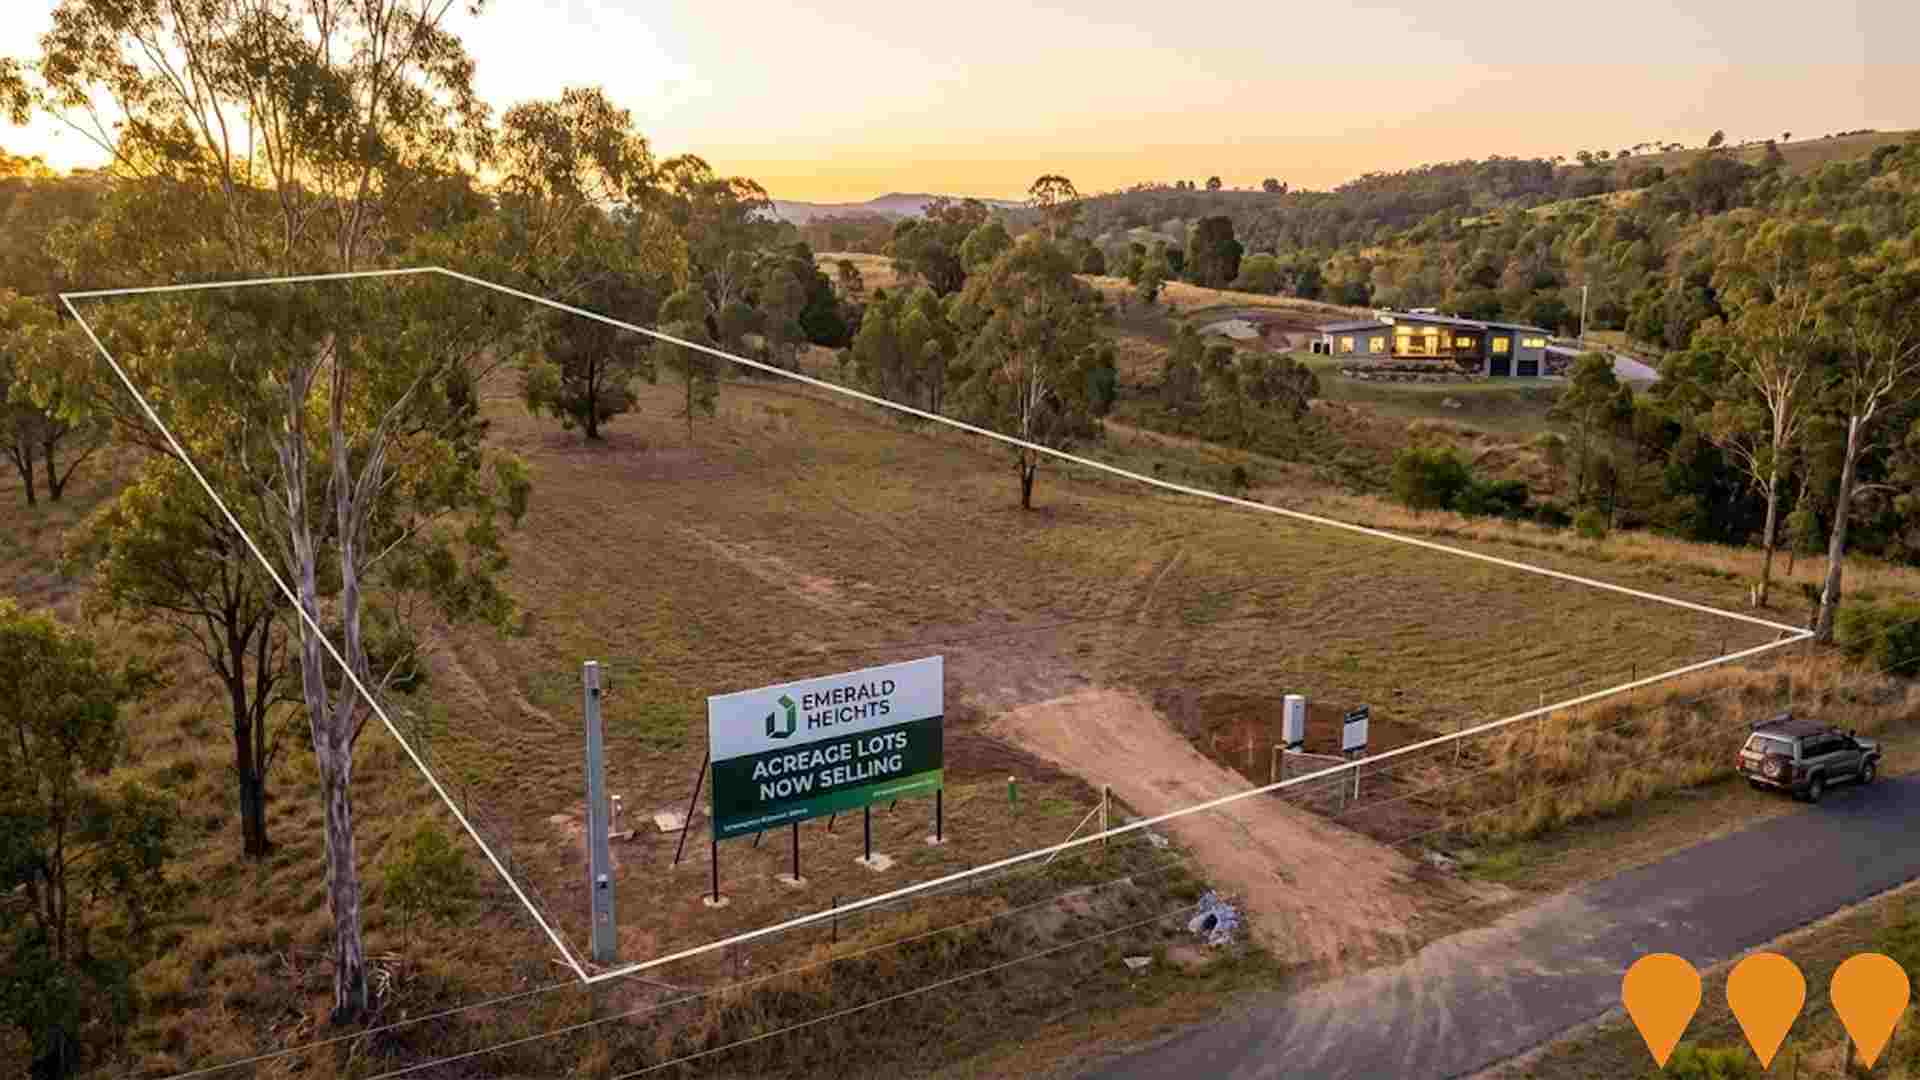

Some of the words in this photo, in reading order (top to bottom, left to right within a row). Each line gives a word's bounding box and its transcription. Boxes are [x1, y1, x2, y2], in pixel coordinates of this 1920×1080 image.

[802, 680, 895, 711] EMERALD
[807, 700, 890, 730] HEIGHTS
[752, 743, 852, 781] ACREAGE
[858, 731, 908, 757] LOTS
[760, 774, 814, 801] NOW
[819, 755, 903, 789] SELLING
